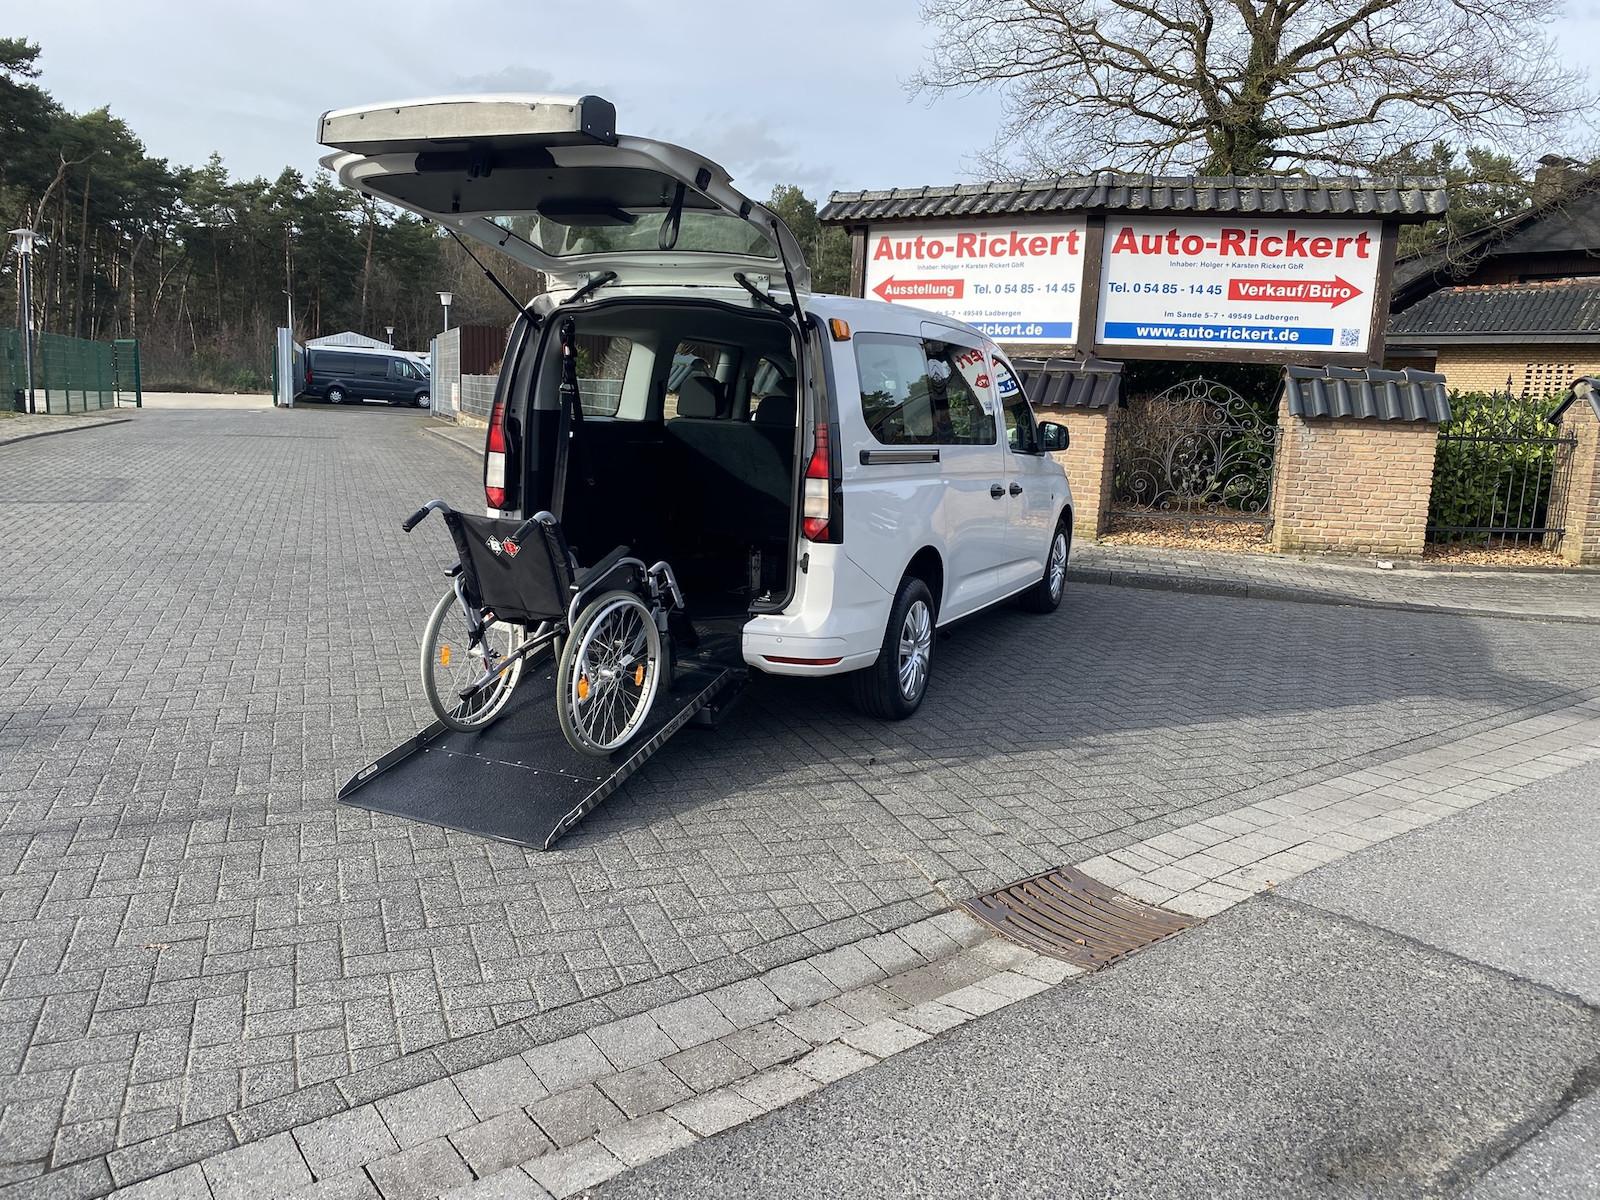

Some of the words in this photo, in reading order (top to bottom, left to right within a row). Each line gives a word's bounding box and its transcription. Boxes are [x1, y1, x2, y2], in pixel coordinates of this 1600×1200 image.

[873, 229, 1080, 261] Auto-Rickert
[1111, 227, 1371, 259] Auto-Rickert
[1170, 260, 1198, 268] Inhaber:
[1200, 261, 1223, 269] Holger
[1231, 261, 1259, 269] Karsten
[1260, 262, 1287, 270] Rickert
[1288, 262, 1304, 270] GbR
[884, 284, 955, 297] Ausstellung
[973, 284, 991, 294] Tel.
[1108, 282, 1130, 293] Tel.
[1238, 282, 1351, 299] Verkauf/Büro
[1177, 311, 1203, 319] Sande
[1227, 312, 1252, 320] 49549
[1254, 313, 1300, 322] Ladbergen
[1136, 326, 1300, 342] www.auto-rickert.de
